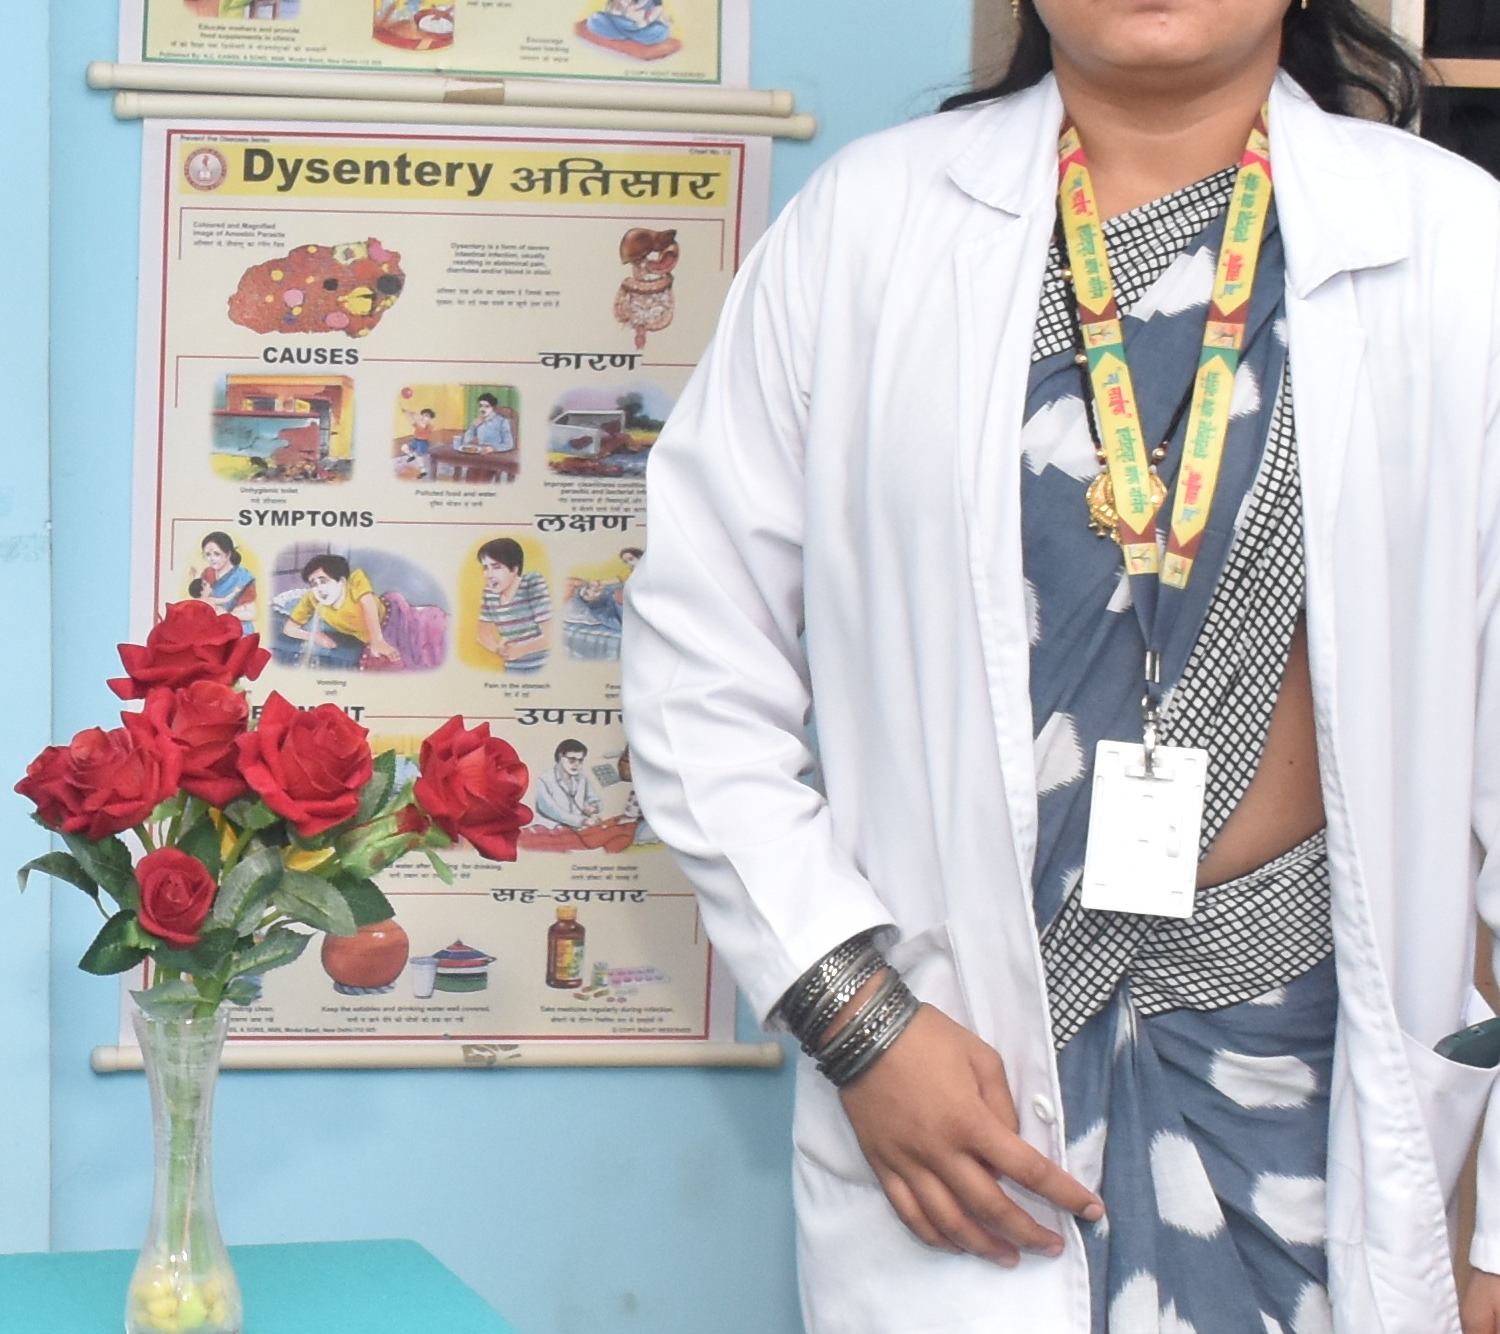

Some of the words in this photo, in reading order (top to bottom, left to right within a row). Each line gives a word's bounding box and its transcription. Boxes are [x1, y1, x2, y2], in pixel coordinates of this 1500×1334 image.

[241, 149, 494, 197] Dysentery
[510, 158, 721, 200] अतिसार
[262, 346, 360, 366] CAUSES
[538, 351, 643, 371] कारण
[237, 508, 375, 528] SYMPTOMS
[534, 513, 636, 534] लक्षण
[490, 887, 648, 904] सह-उपचार
